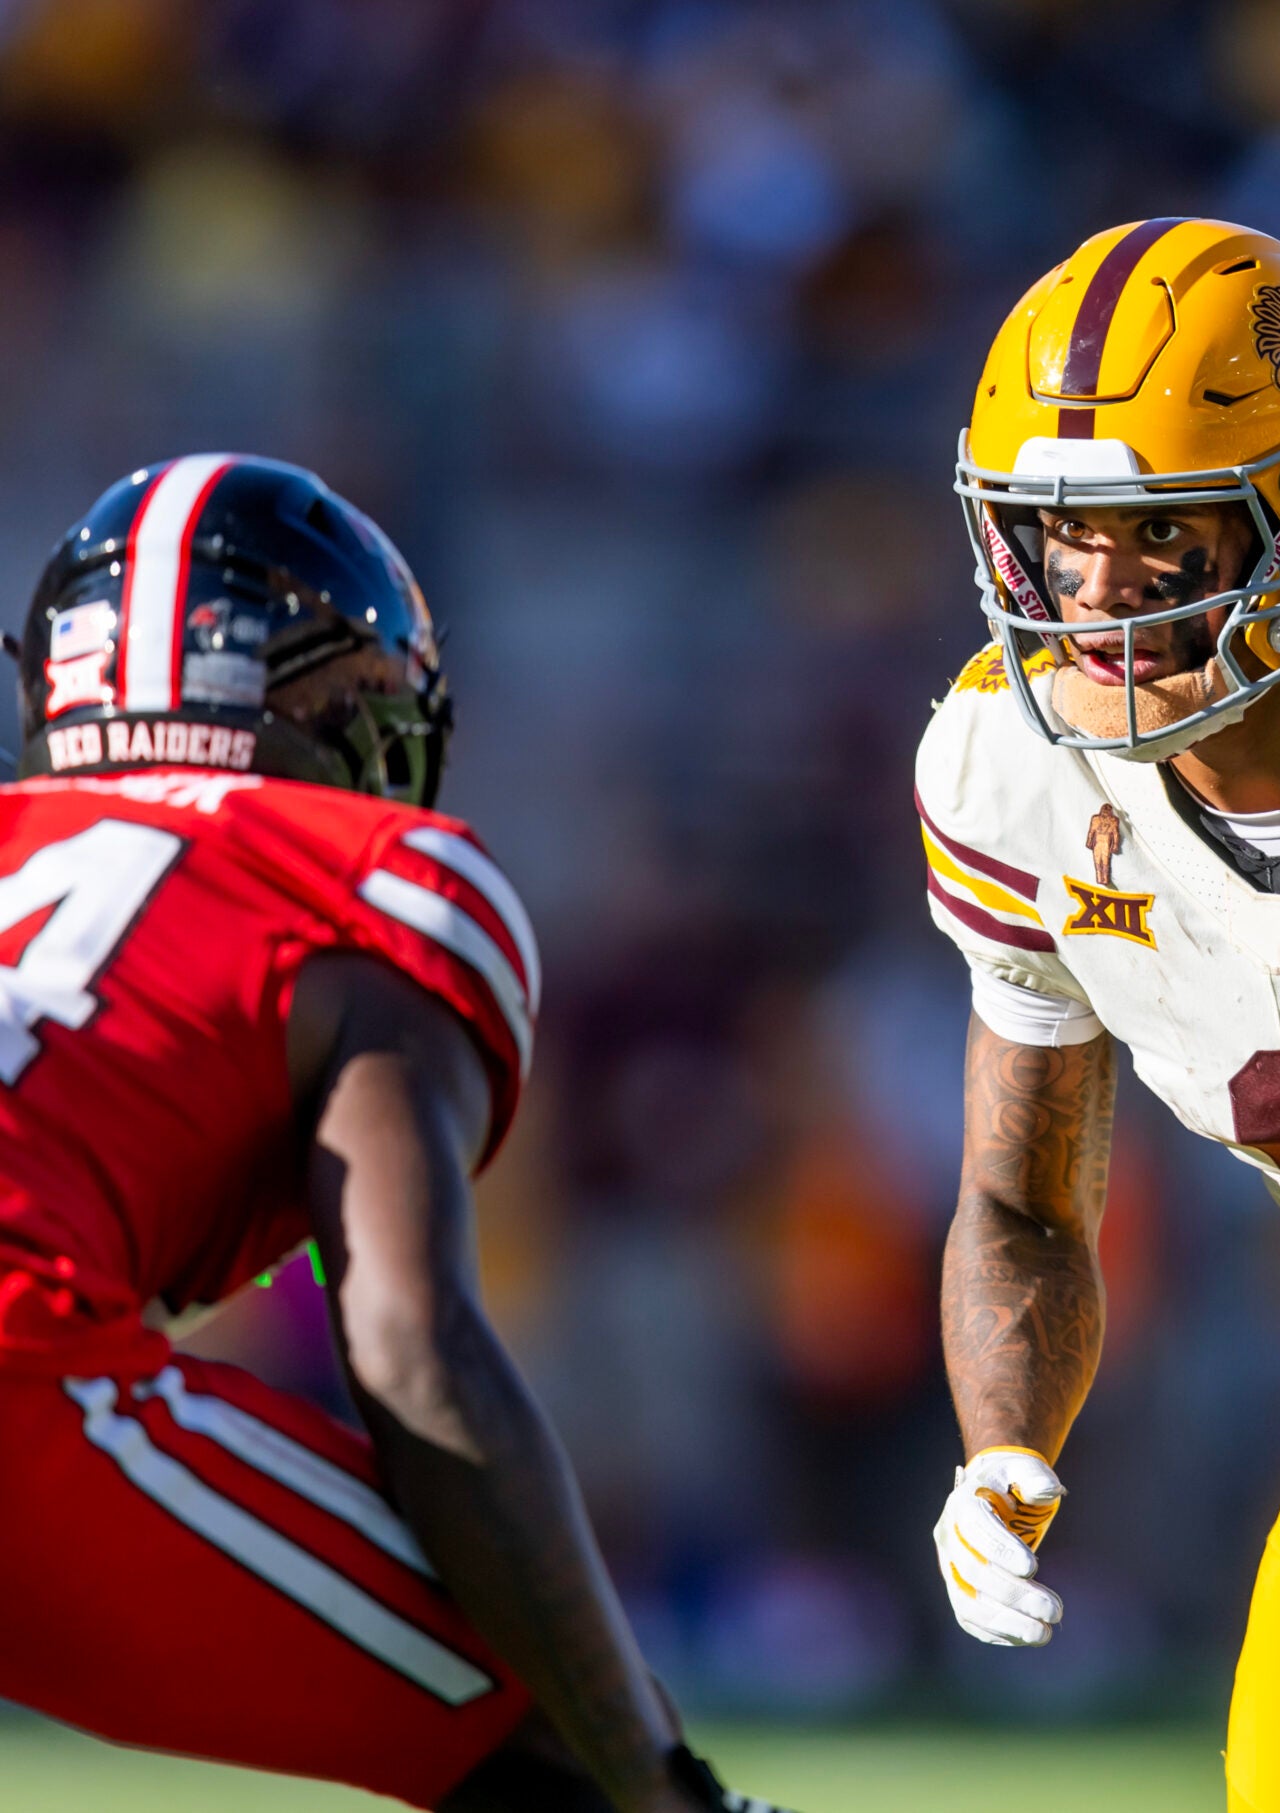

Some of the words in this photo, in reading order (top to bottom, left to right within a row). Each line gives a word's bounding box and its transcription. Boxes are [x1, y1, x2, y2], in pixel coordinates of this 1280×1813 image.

[1017, 589, 1058, 646] STAE
[48, 723, 103, 772] RED
[106, 720, 257, 771] RAIDERS
[1068, 882, 1153, 944] XII
